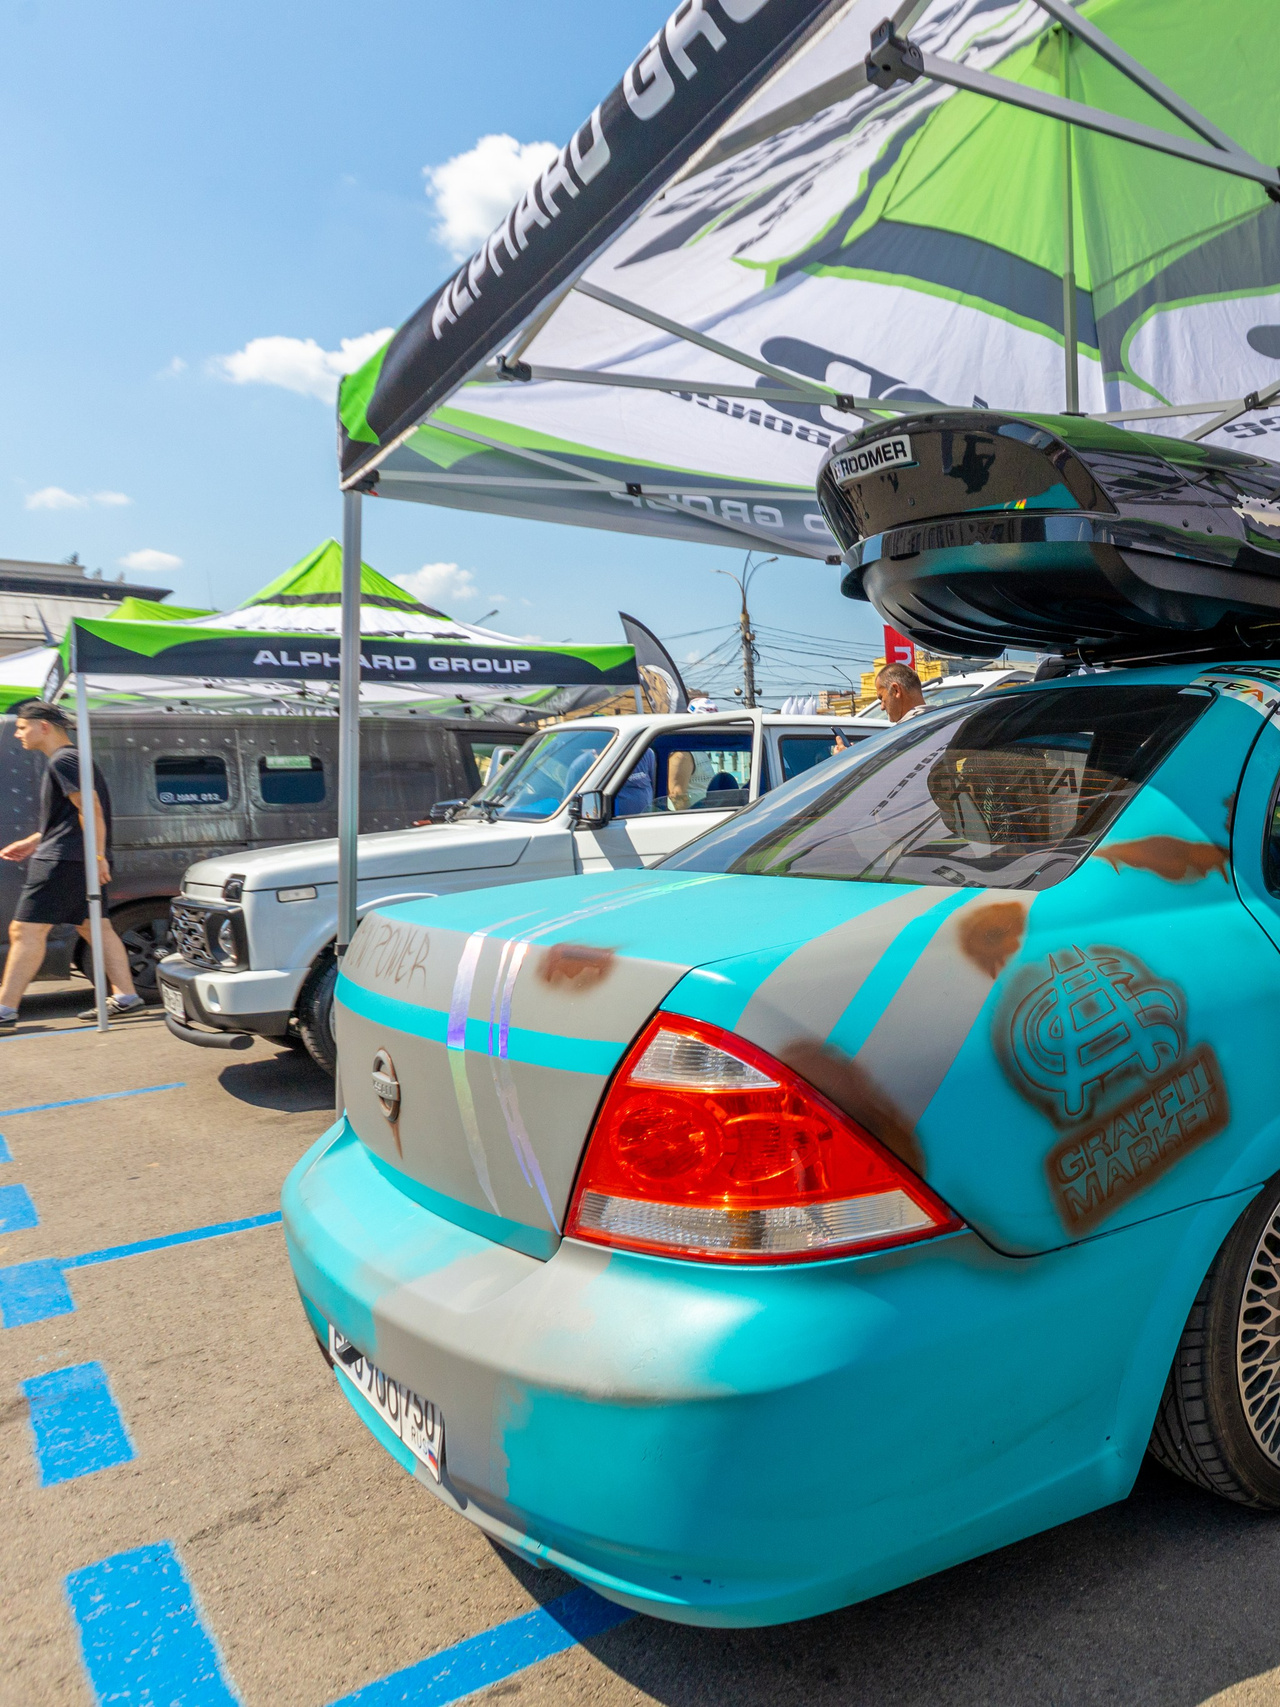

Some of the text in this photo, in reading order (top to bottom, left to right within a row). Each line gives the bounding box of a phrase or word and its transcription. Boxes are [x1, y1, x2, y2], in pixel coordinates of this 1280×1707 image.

[431, 103, 611, 340] ALPHARD
[253, 650, 532, 674] ALPHARD GROUP
[1058, 1051, 1215, 1185] GRAFFITI
[1062, 1087, 1217, 1223] MARKET
